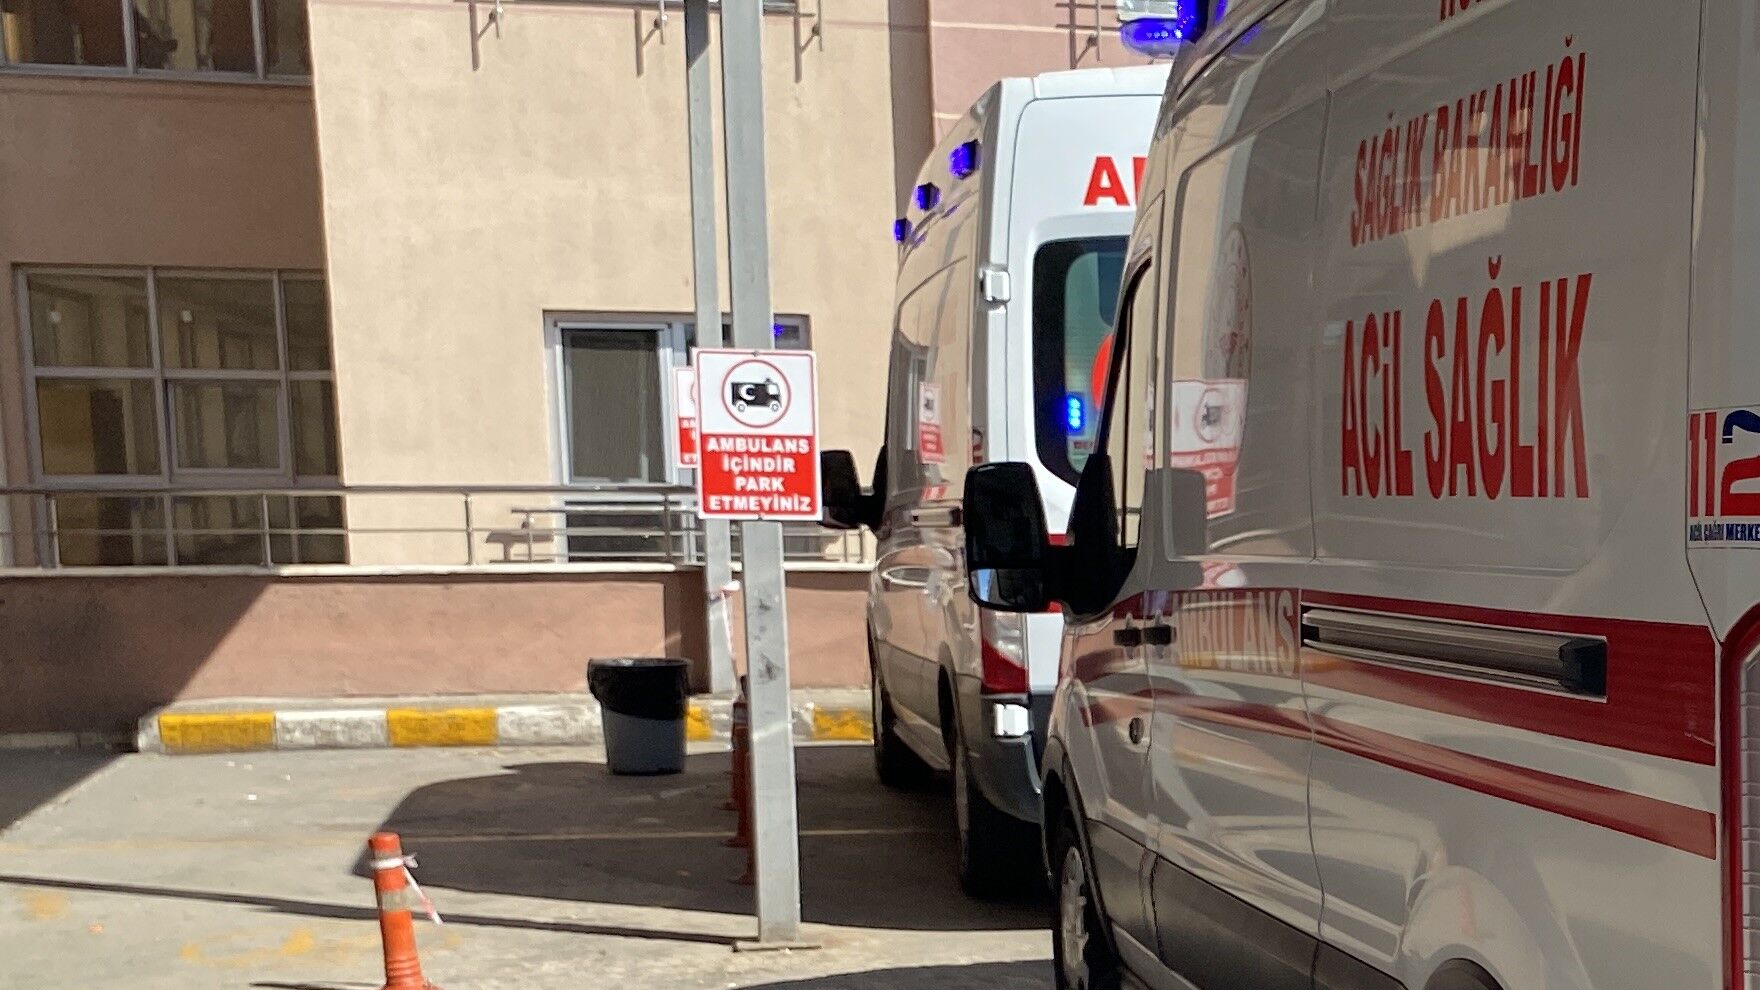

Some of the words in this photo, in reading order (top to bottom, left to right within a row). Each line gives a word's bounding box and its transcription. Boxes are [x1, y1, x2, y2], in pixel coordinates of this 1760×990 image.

[1351, 112, 1429, 247] SAĞLIK
[1430, 34, 1586, 222] BAKANLIĞI
[1423, 255, 1593, 500] SAĞLIK
[707, 436, 811, 455] AMBULANS
[722, 453, 797, 475] İÇİNDİR
[734, 476, 786, 492] PARK
[708, 493, 812, 512] ETMEYİNİZ
